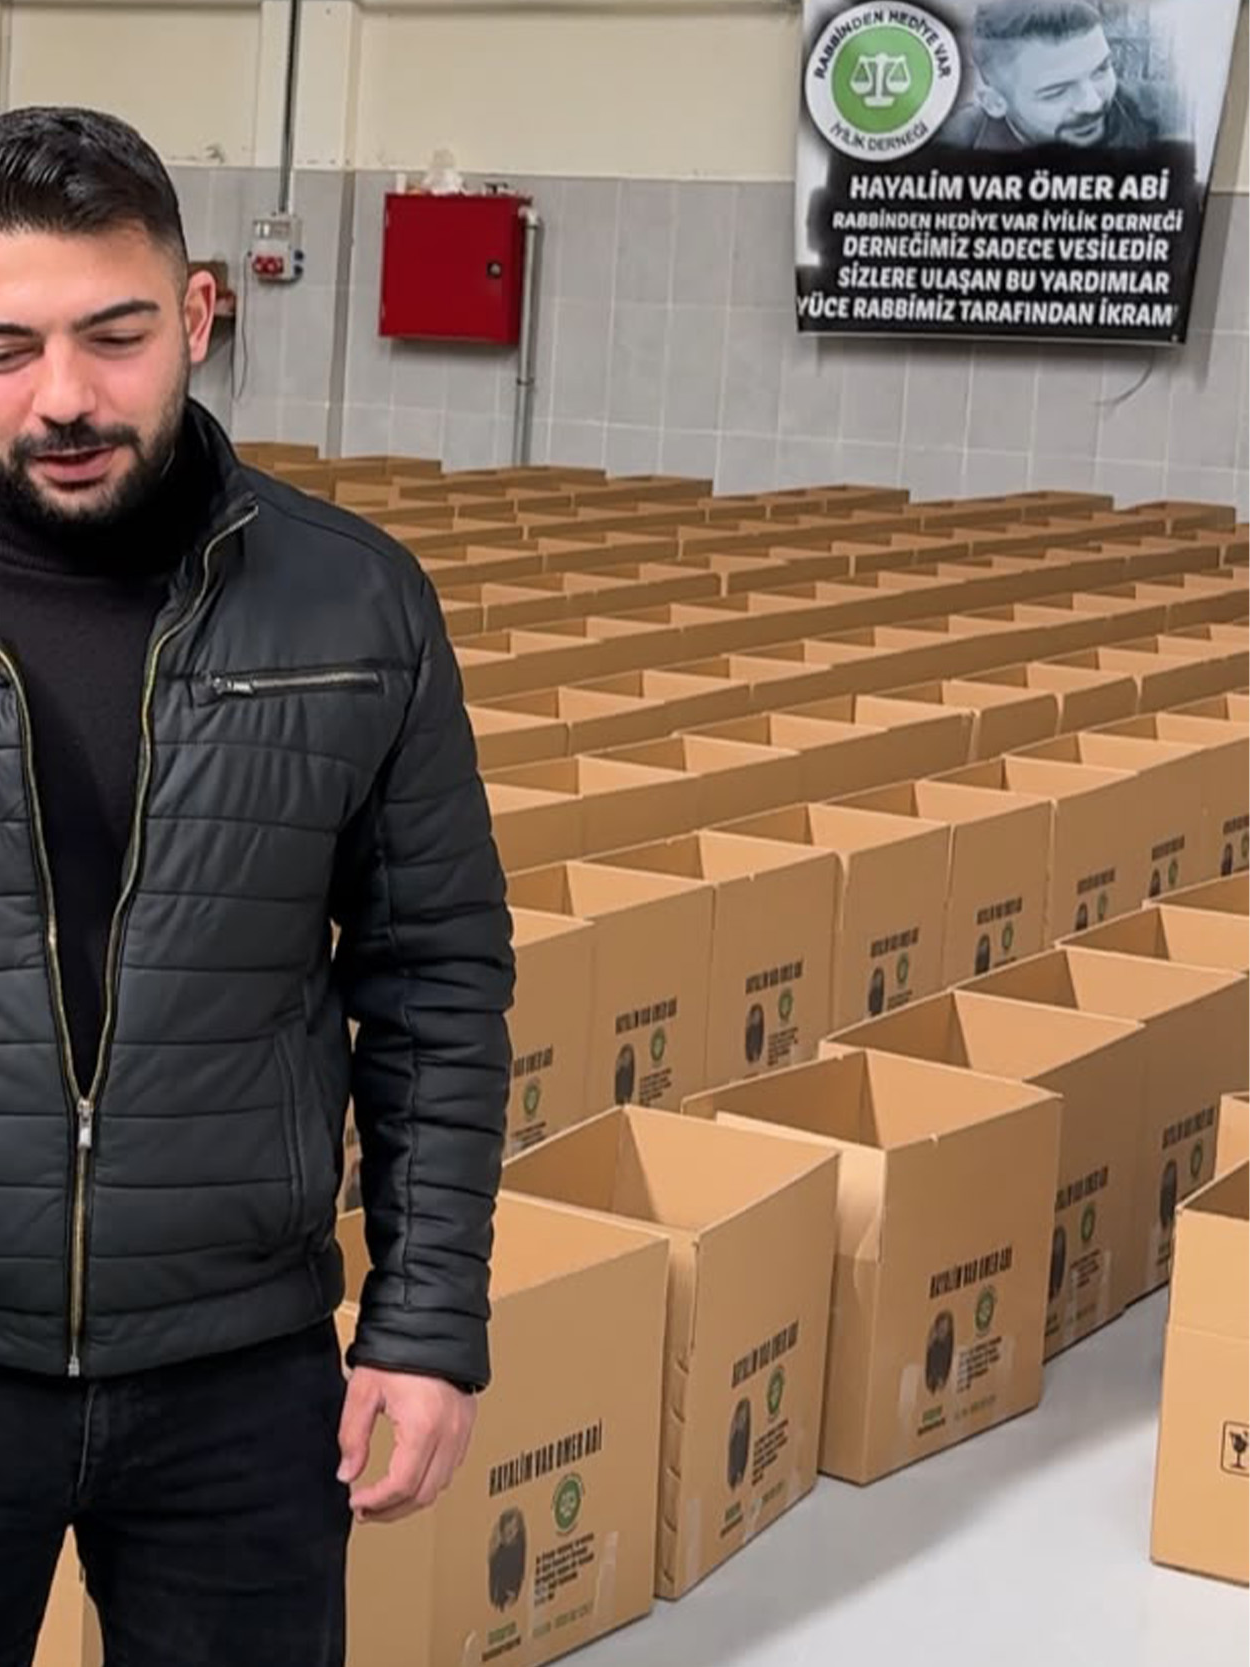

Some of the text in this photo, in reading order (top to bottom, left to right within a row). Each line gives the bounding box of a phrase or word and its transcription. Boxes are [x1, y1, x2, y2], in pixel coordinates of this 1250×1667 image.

[934, 43, 952, 79] VAR
[850, 168, 1170, 201] HAYALİM VAR ÖMER ABİ
[832, 207, 1184, 232] RABBİNDEN HEDİYE VAR İYİLİK DERNEĞİ
[842, 231, 1170, 261] DERNEĞİMİZ SADECE VESİLEDİR
[837, 260, 1170, 296] SİZLERE ULAŞAN BU YARDIMLAR
[795, 291, 851, 319] YÜCE
[852, 292, 956, 322] RABBİMİZ
[959, 299, 1095, 325] TARAFINDAN
